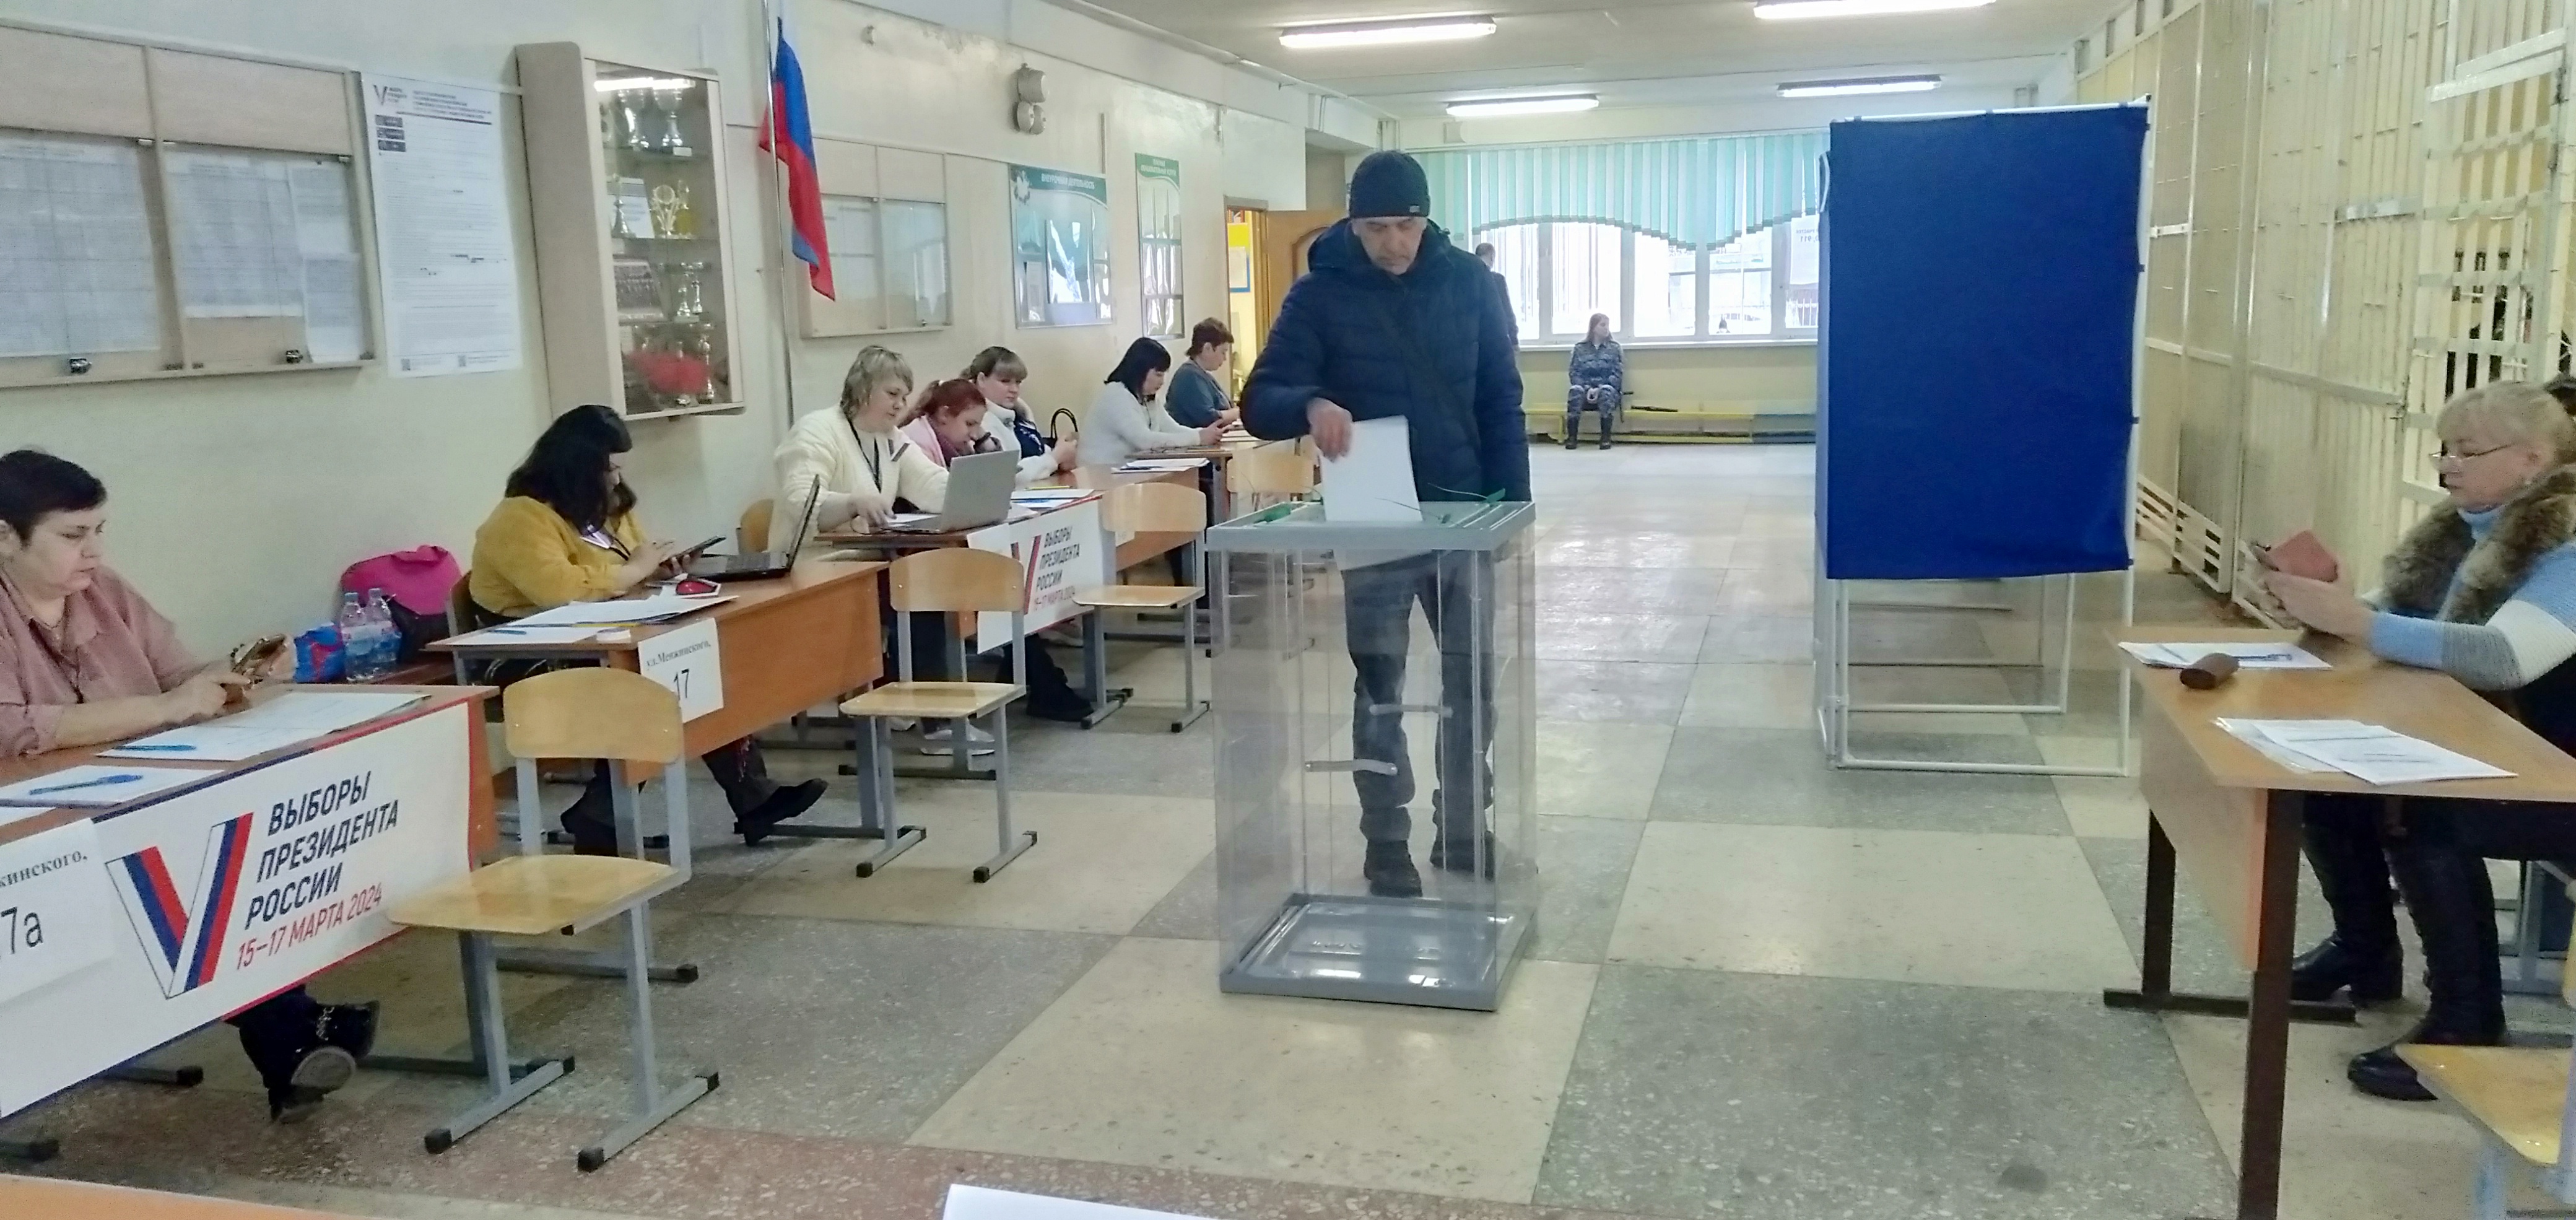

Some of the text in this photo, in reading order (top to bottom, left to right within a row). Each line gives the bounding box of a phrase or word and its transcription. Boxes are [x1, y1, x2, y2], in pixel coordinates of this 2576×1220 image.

[672, 668, 690, 701] 17
[268, 770, 372, 836] ВЫБОРЫ
[257, 799, 399, 883] ПРЕЗИДЕНТА
[245, 861, 344, 930] РОССИИ
[288, 902, 344, 948] МАРТА
[347, 882, 383, 922] 2024
[0, 906, 43, 955] 7а
